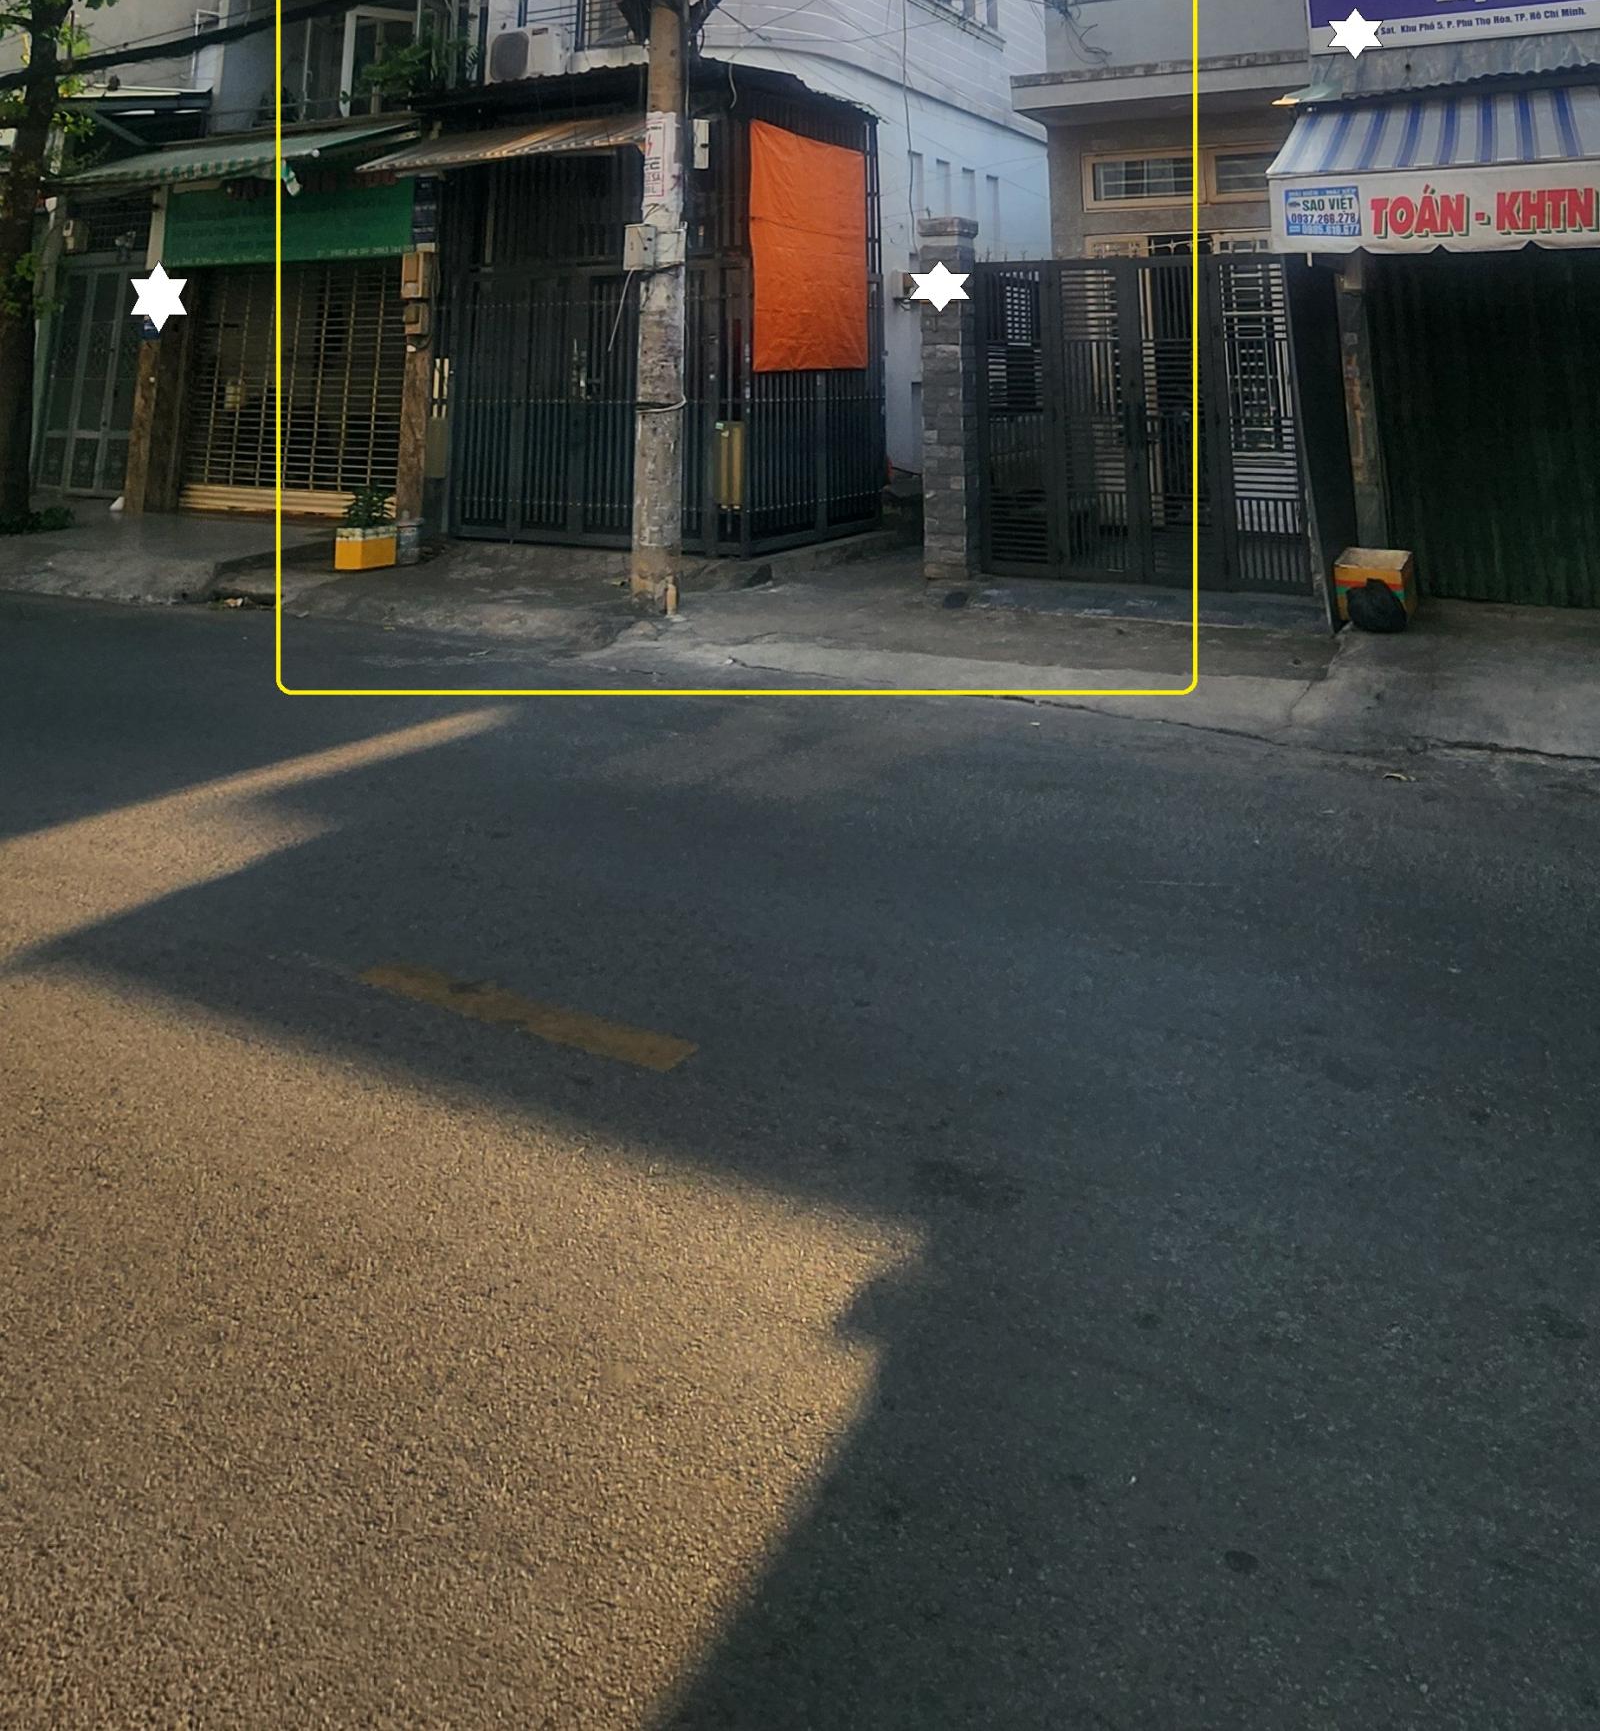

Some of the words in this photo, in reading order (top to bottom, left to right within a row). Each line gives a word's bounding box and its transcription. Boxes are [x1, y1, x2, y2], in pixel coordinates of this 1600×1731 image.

[1401, 25, 1417, 34] Khu
[1302, 199, 1325, 212] SAO
[1328, 195, 1354, 213] VIỆT
[1371, 184, 1468, 238] TOÁN
[1496, 188, 1599, 234] KHTN
